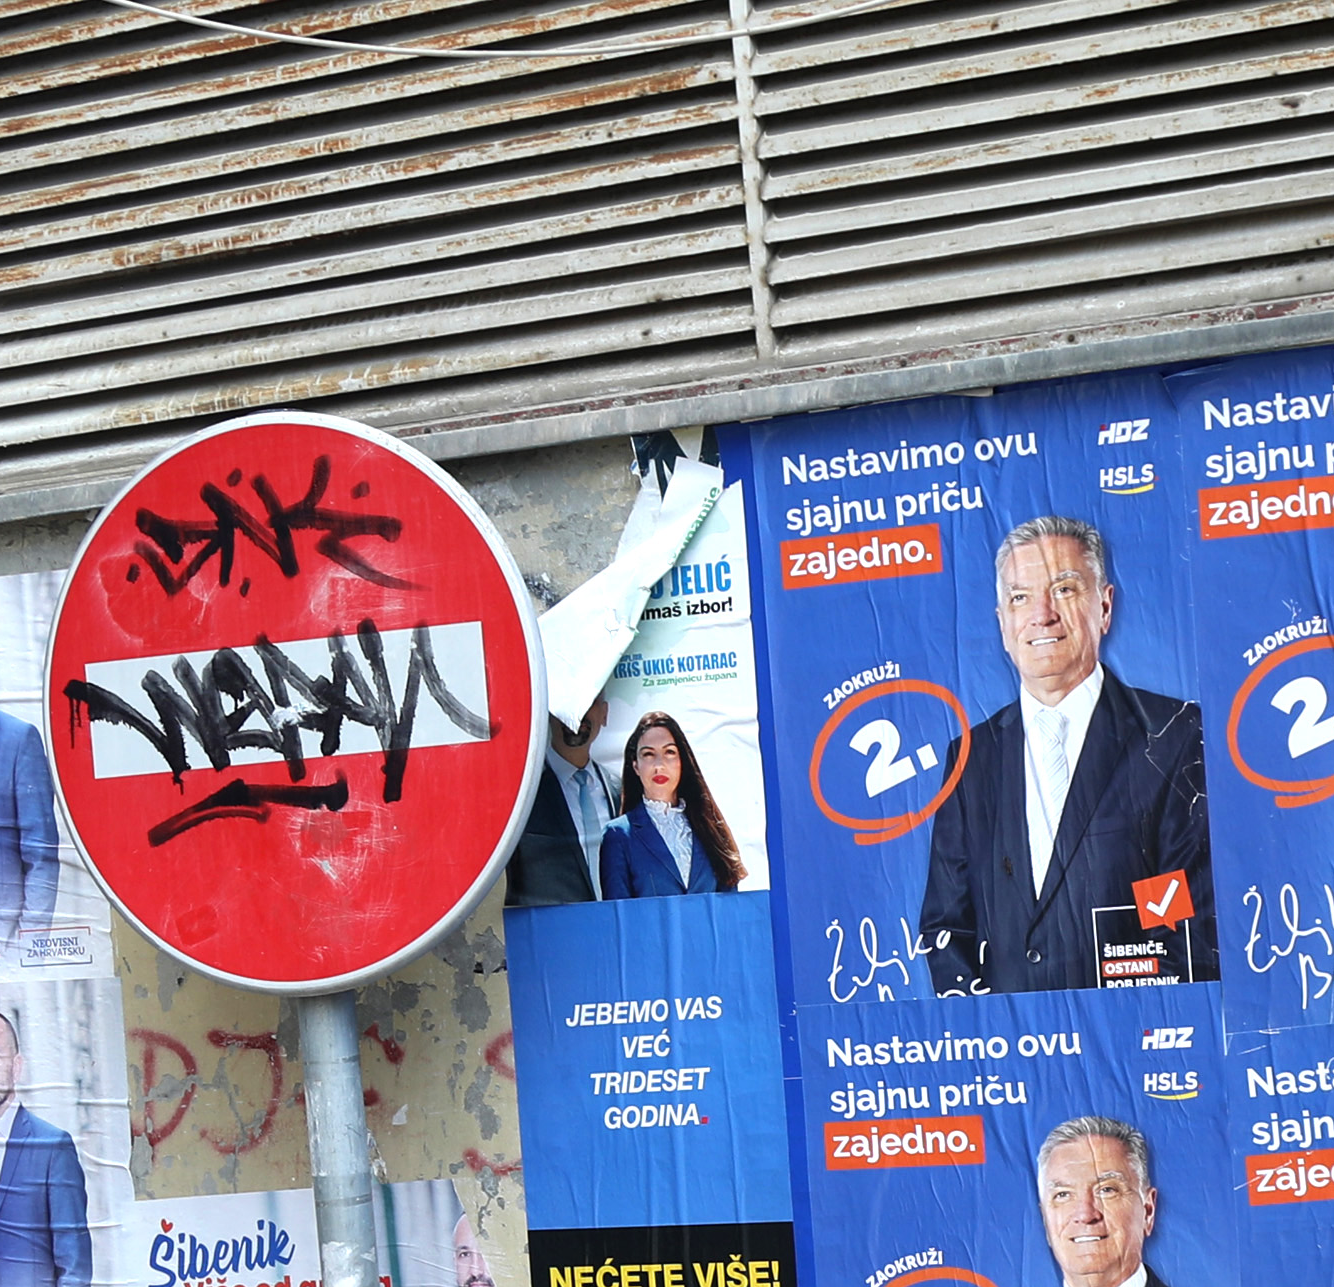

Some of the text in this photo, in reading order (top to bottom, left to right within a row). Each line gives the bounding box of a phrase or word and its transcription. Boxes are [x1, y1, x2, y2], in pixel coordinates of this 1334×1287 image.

[1098, 418, 1150, 446] HDZ
[781, 431, 1037, 485] Nastavimo ovu
[1205, 443, 1316, 485] sjajnu
[1099, 463, 1155, 489] HSLS
[786, 482, 984, 536] sjajnu priču
[788, 537, 934, 583] zajedno.
[671, 554, 731, 597] JELIĆ
[687, 597, 733, 616] izbor!
[1243, 618, 1327, 666] ZAOKRUŽI
[643, 653, 674, 676] UKIĆ
[678, 651, 737, 672] KOTARAC
[642, 671, 737, 687] Za zamjenicu župana
[822, 662, 901, 710] ZAOKRUŽI
[848, 719, 938, 798] 2.
[27, 947, 85, 957] ZA HRVATSKU
[32, 937, 78, 948] NEOVISNI
[1104, 941, 1167, 957] ŠIBENIČE,
[1105, 960, 1152, 974] OSTANI
[566, 996, 722, 1028] JEBEMO VAS
[622, 1030, 670, 1058] VEĆ
[1141, 1027, 1194, 1050] HDZ
[590, 1067, 710, 1095] TRIDESET
[1143, 1071, 1198, 1093] HSLS
[604, 1103, 709, 1129] GODINA.
[832, 1127, 976, 1164] zajedno.
